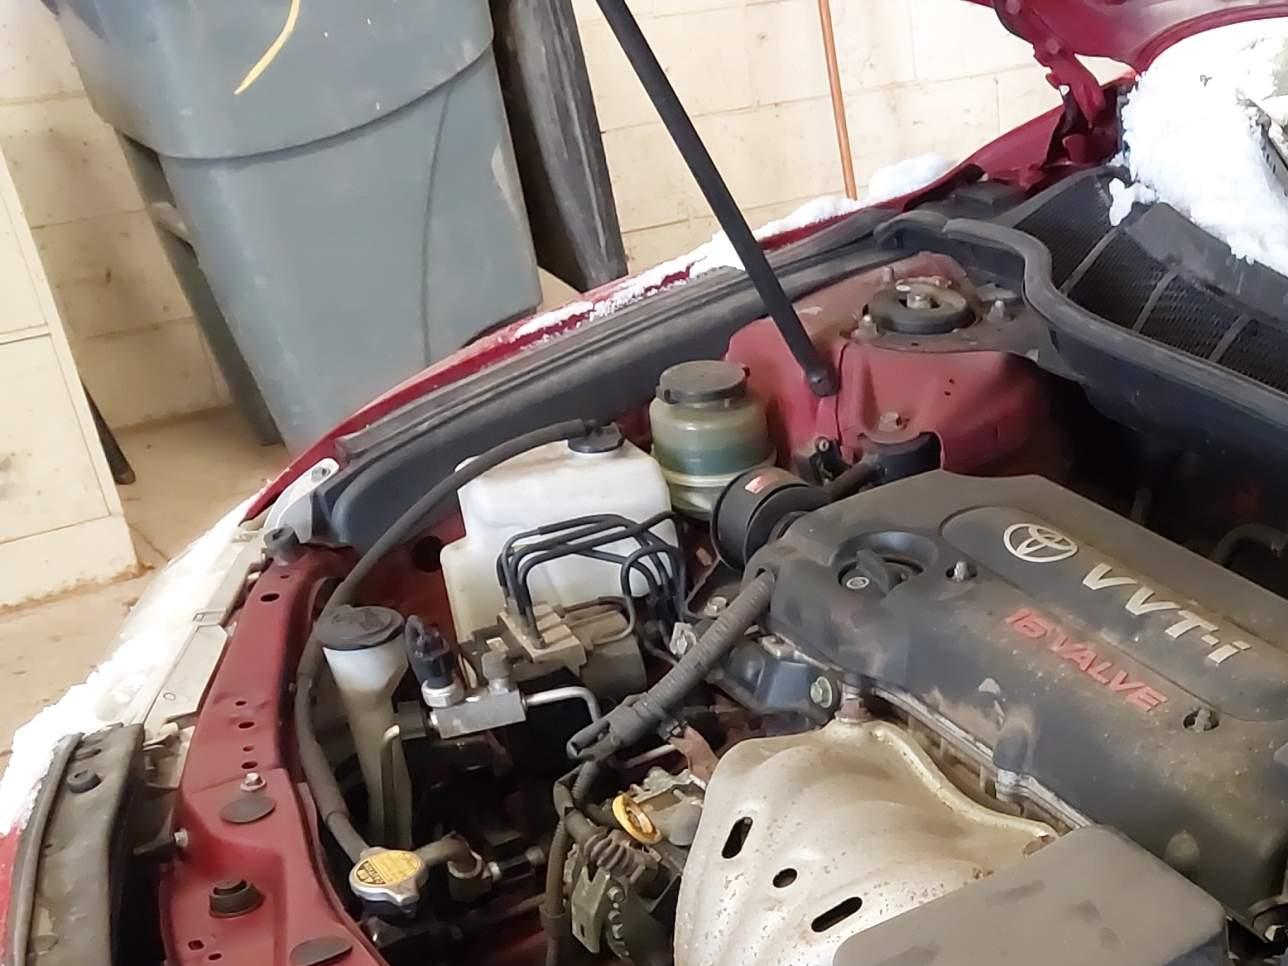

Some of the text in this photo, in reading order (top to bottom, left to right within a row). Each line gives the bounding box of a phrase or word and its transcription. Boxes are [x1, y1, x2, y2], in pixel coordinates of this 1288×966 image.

[1005, 607, 1169, 712] 16 VALVE
[1082, 562, 1252, 665] VVT-i
